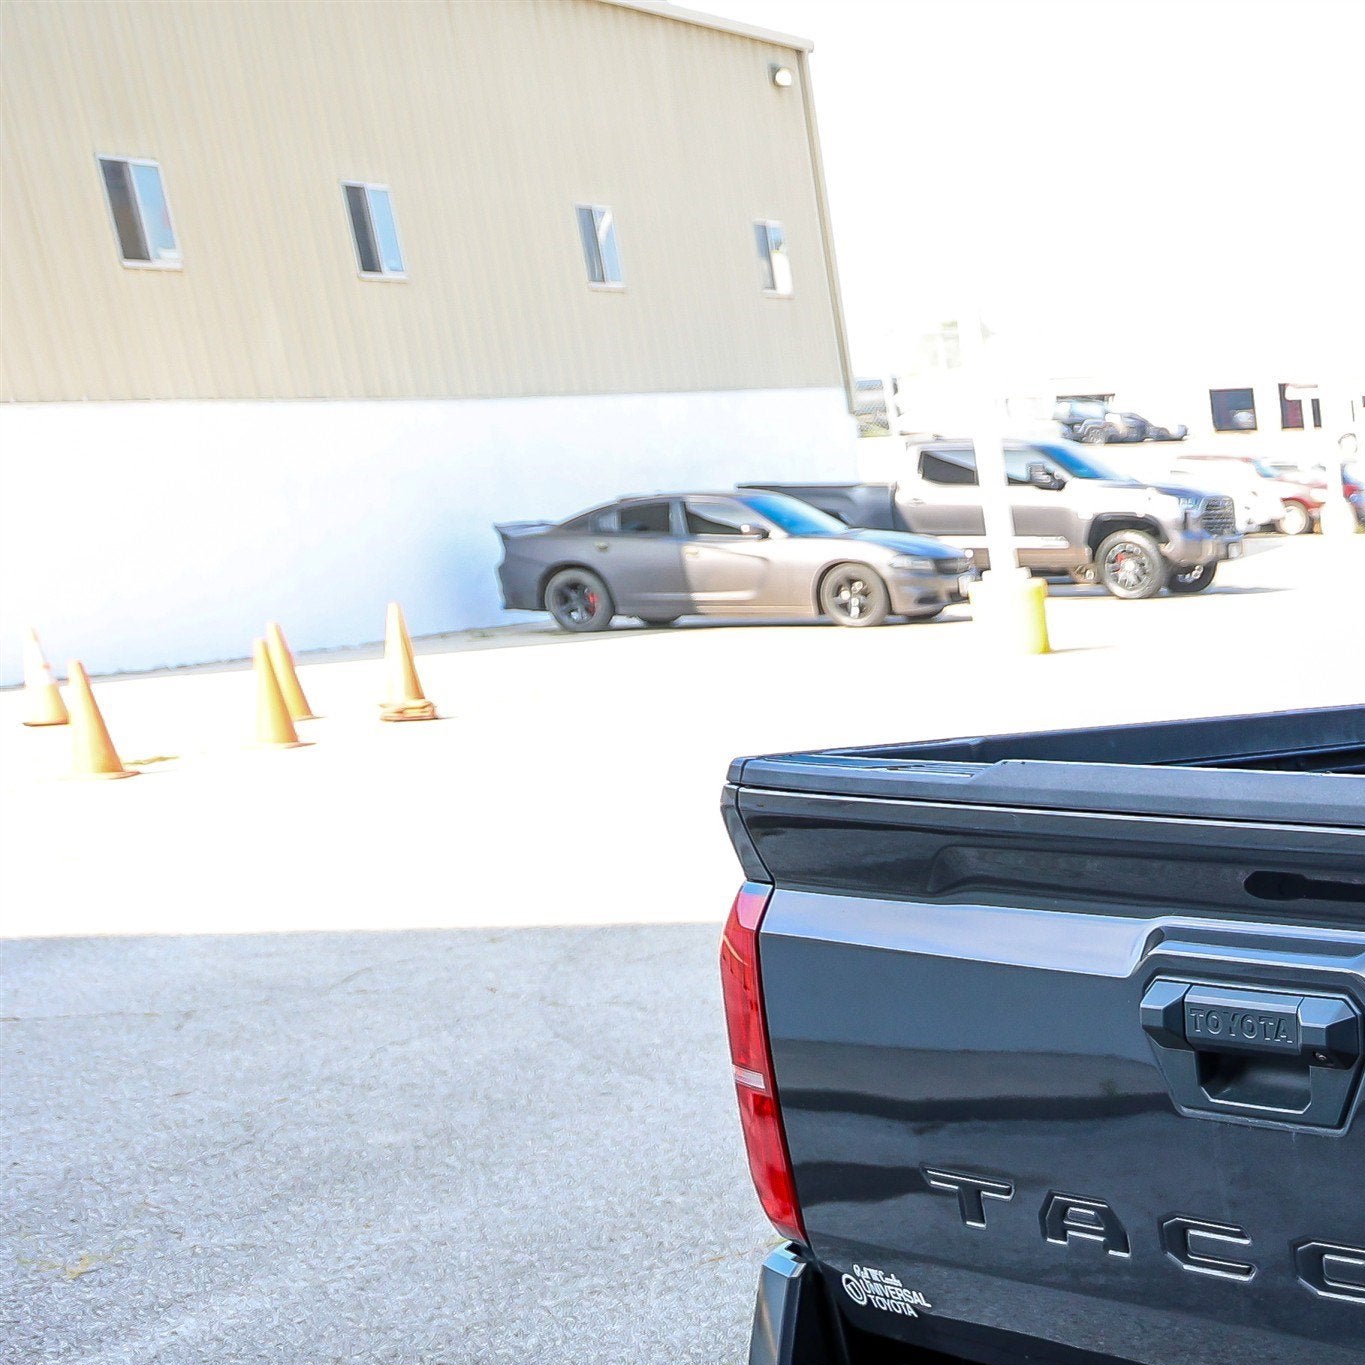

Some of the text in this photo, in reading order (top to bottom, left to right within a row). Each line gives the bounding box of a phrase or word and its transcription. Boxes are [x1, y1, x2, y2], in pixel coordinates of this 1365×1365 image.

[1189, 1008, 1293, 1044] TOYOTA
[859, 1279, 932, 1308] UNIVERSAL
[867, 1294, 919, 1318] TOYOTA
